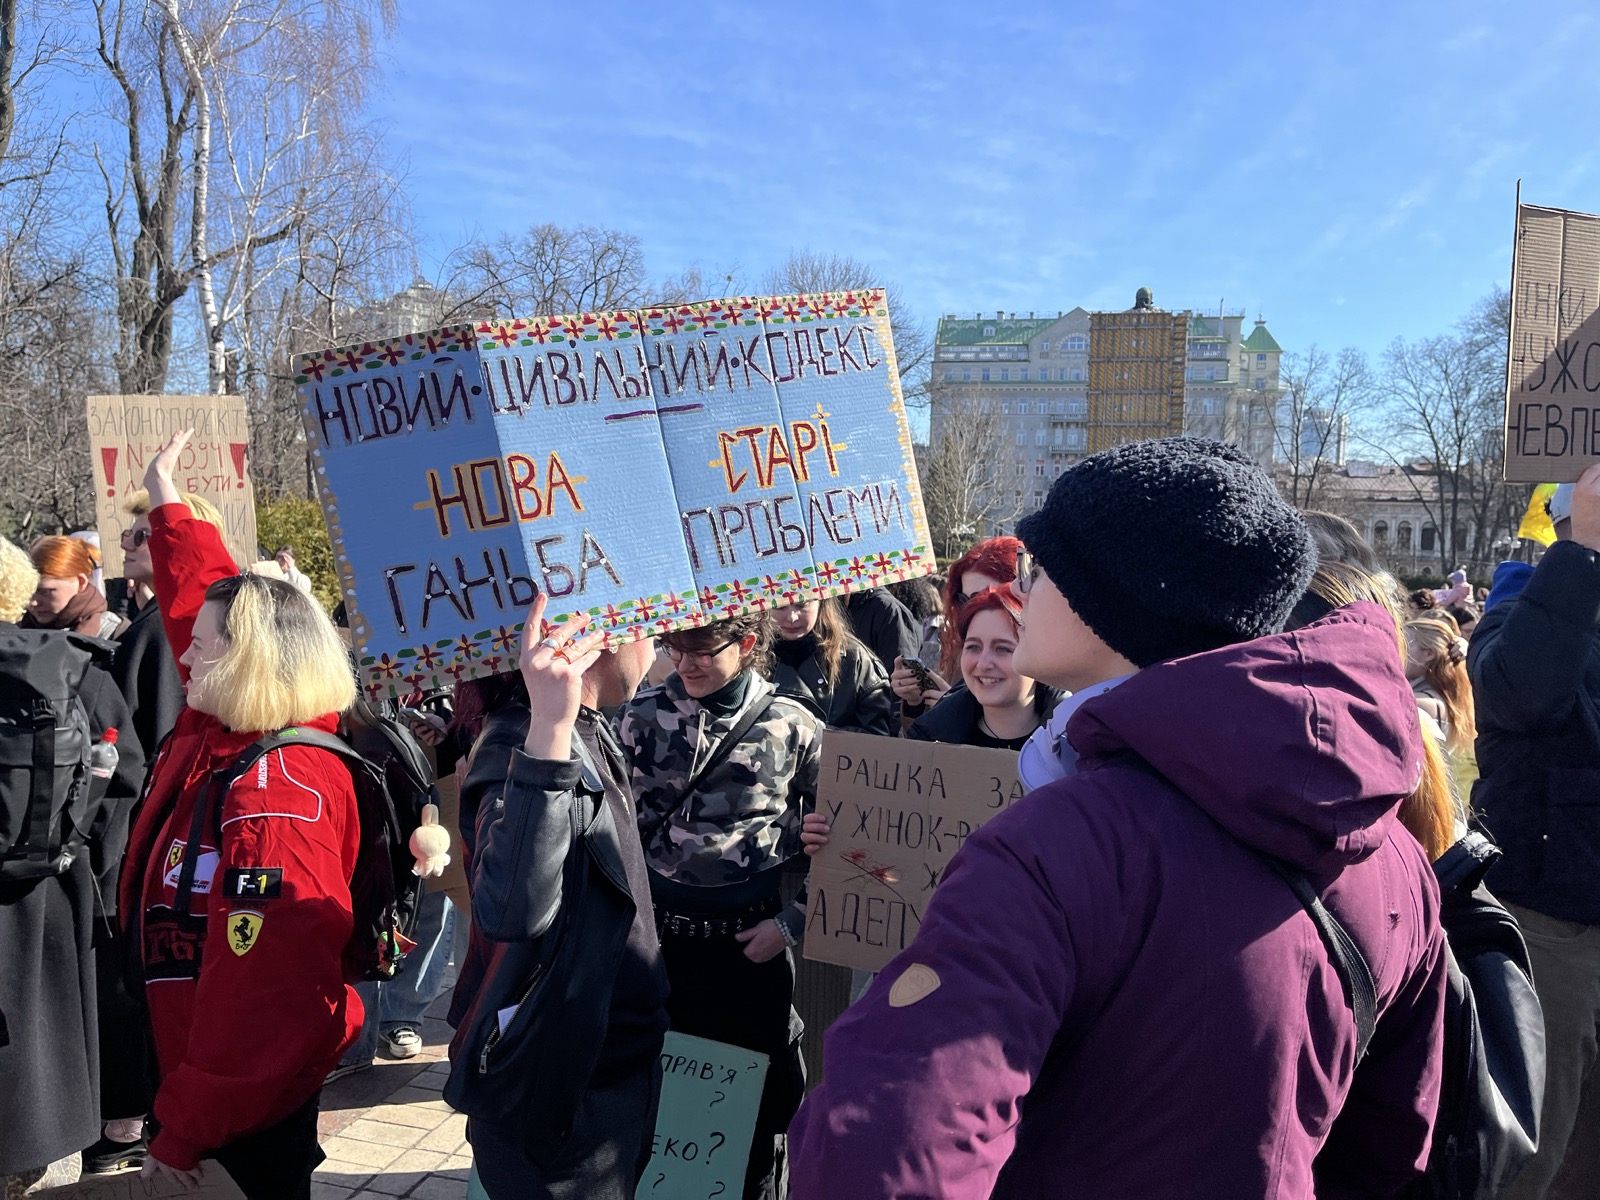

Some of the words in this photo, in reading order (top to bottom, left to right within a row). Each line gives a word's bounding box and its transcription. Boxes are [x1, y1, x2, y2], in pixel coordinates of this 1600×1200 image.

[315, 357, 472, 446] НОВИЙ
[482, 331, 734, 416] ЦИВІЛЬНИЙ
[739, 325, 880, 388] КОДЕКС
[187, 475, 231, 493] БУТИ
[718, 413, 840, 493] СТАРІ
[427, 451, 584, 538] НОВА
[682, 480, 906, 572] ПРОБЛЕМИ
[385, 528, 623, 636] ГАНЬБА
[836, 755, 946, 799] РАШКА
[852, 803, 982, 853] ЖІНОК-
[237, 874, 267, 895] F-1
